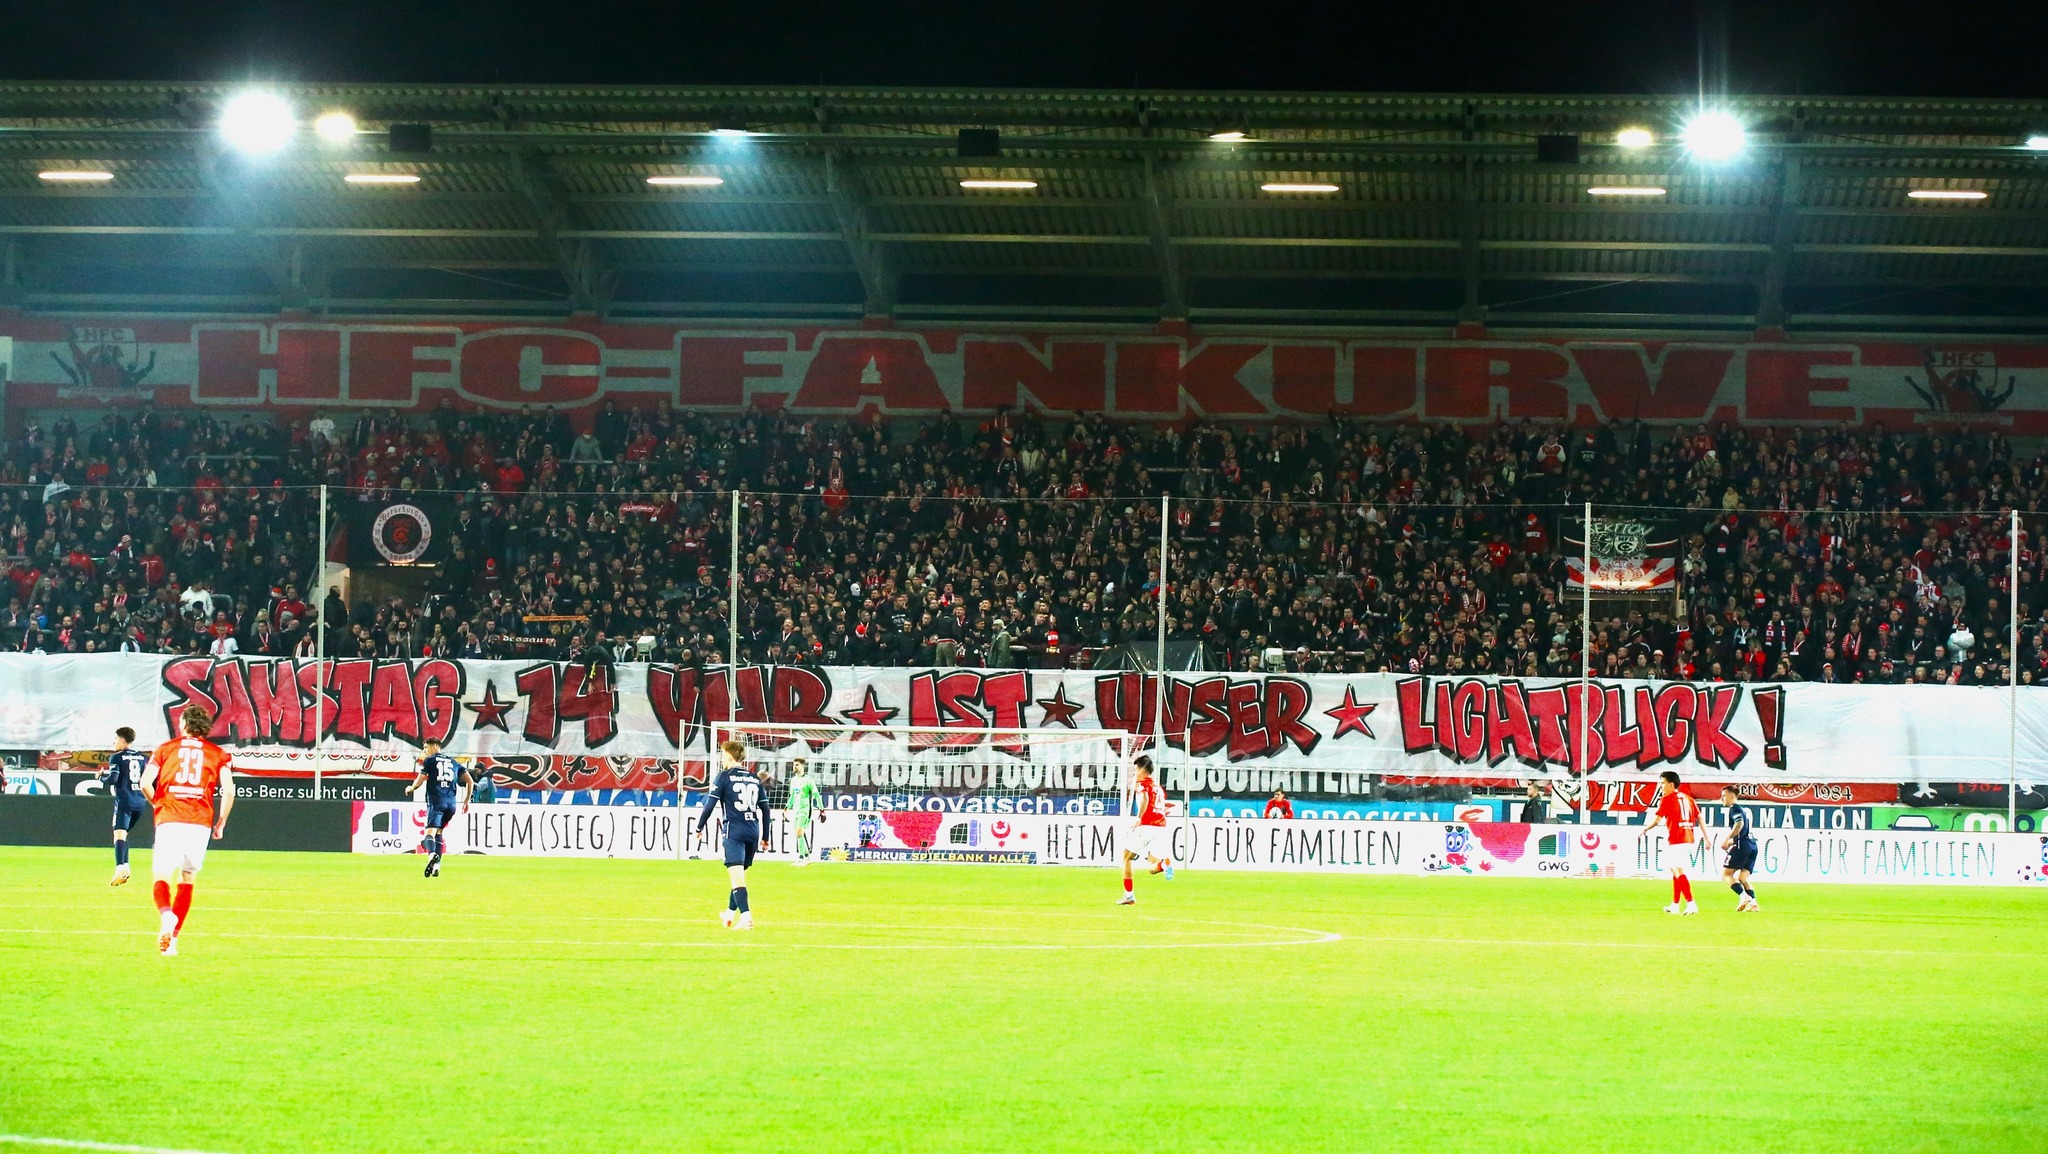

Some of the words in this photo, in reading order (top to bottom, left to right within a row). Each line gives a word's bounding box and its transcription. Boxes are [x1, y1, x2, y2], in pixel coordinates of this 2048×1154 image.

[162, 655, 466, 748] SAMSTAG
[516, 661, 619, 750] 14
[908, 670, 1032, 761] IST
[1095, 674, 1322, 763] UNSER
[1396, 675, 1748, 778] LICHTBLICK
[129, 760, 141, 783] 8
[175, 748, 204, 785] 33
[436, 761, 454, 782] 15
[341, 785, 376, 800] dich!
[732, 783, 760, 812] 30
[1813, 784, 1853, 801] 1984
[814, 793, 1106, 816] uchs-kovatsch.de
[1700, 806, 1866, 829] UTOMATION
[466, 809, 616, 852] HEIM(SIEG)
[629, 808, 672, 851] FÜR
[371, 837, 403, 848] GWG
[1213, 820, 1257, 864] FÜR
[1270, 828, 1401, 867] FAMILIEN
[1805, 831, 1848, 875] FÜR
[1863, 839, 1996, 877] FAMILIEN
[854, 850, 908, 862] MERKUR
[911, 852, 984, 863] SPIELBANK
[989, 853, 1031, 864] HALLE
[1538, 861, 1570, 872] GWG
